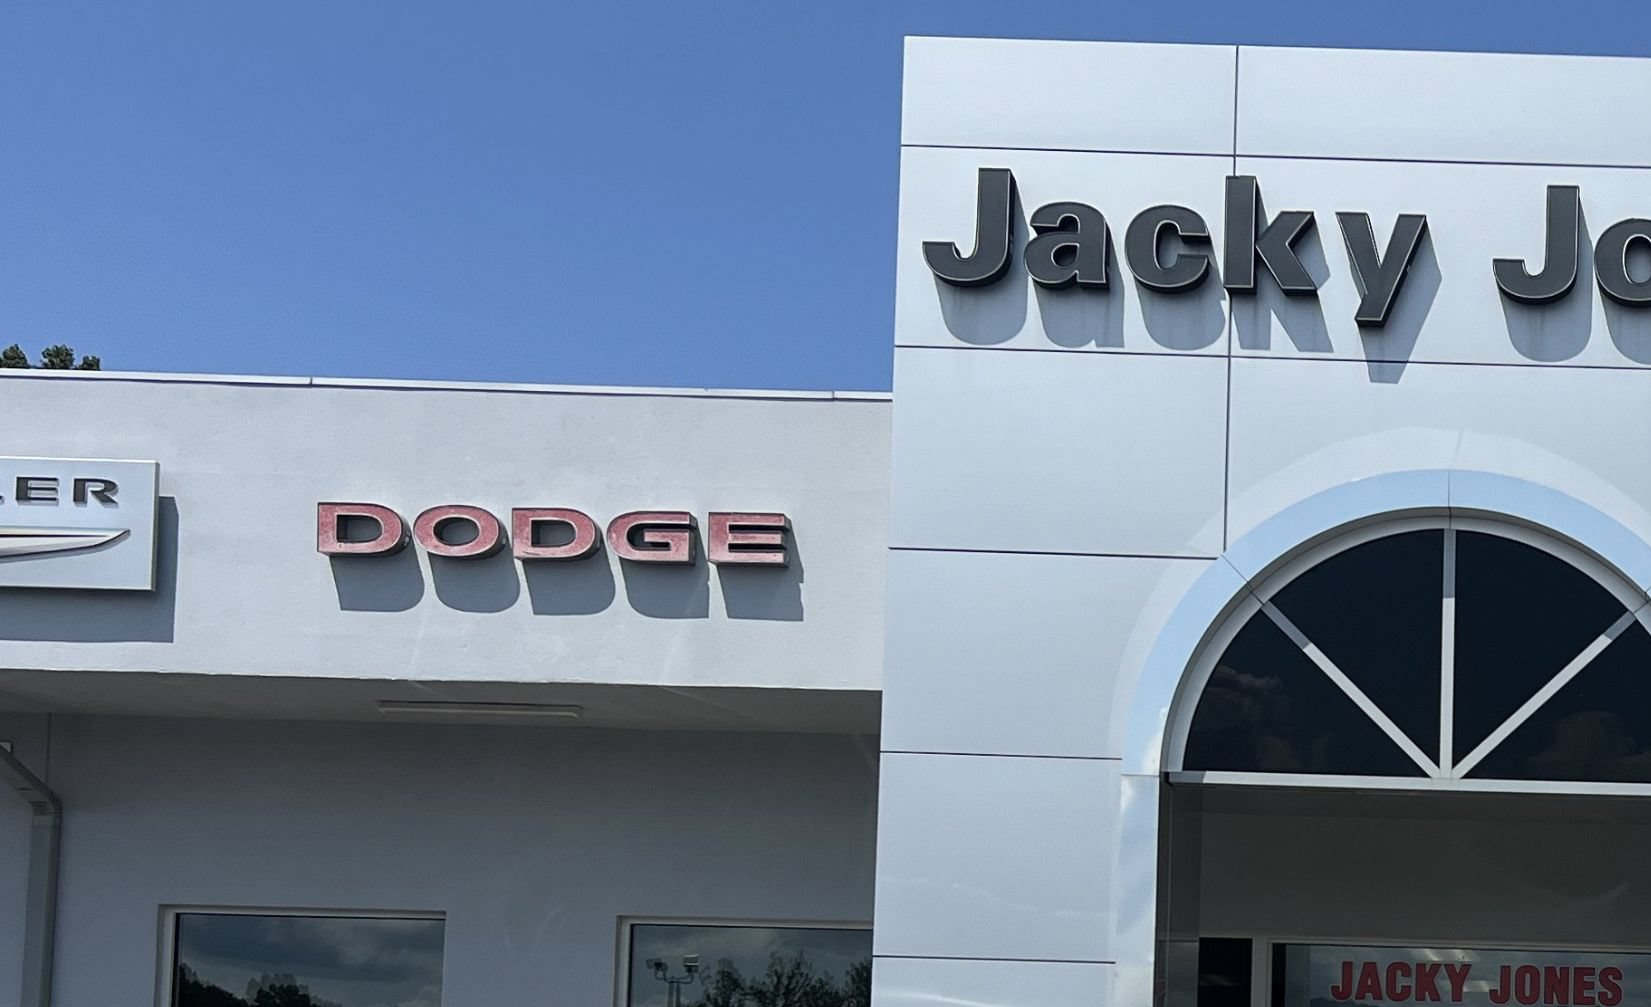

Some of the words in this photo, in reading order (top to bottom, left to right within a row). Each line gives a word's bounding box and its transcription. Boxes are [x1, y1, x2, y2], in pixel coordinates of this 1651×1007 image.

[922, 167, 1427, 327] Jacky
[0, 476, 119, 504] ER
[317, 502, 790, 568] DODGE
[1330, 960, 1472, 1002] JACKY
[1489, 964, 1624, 1007] JONES
